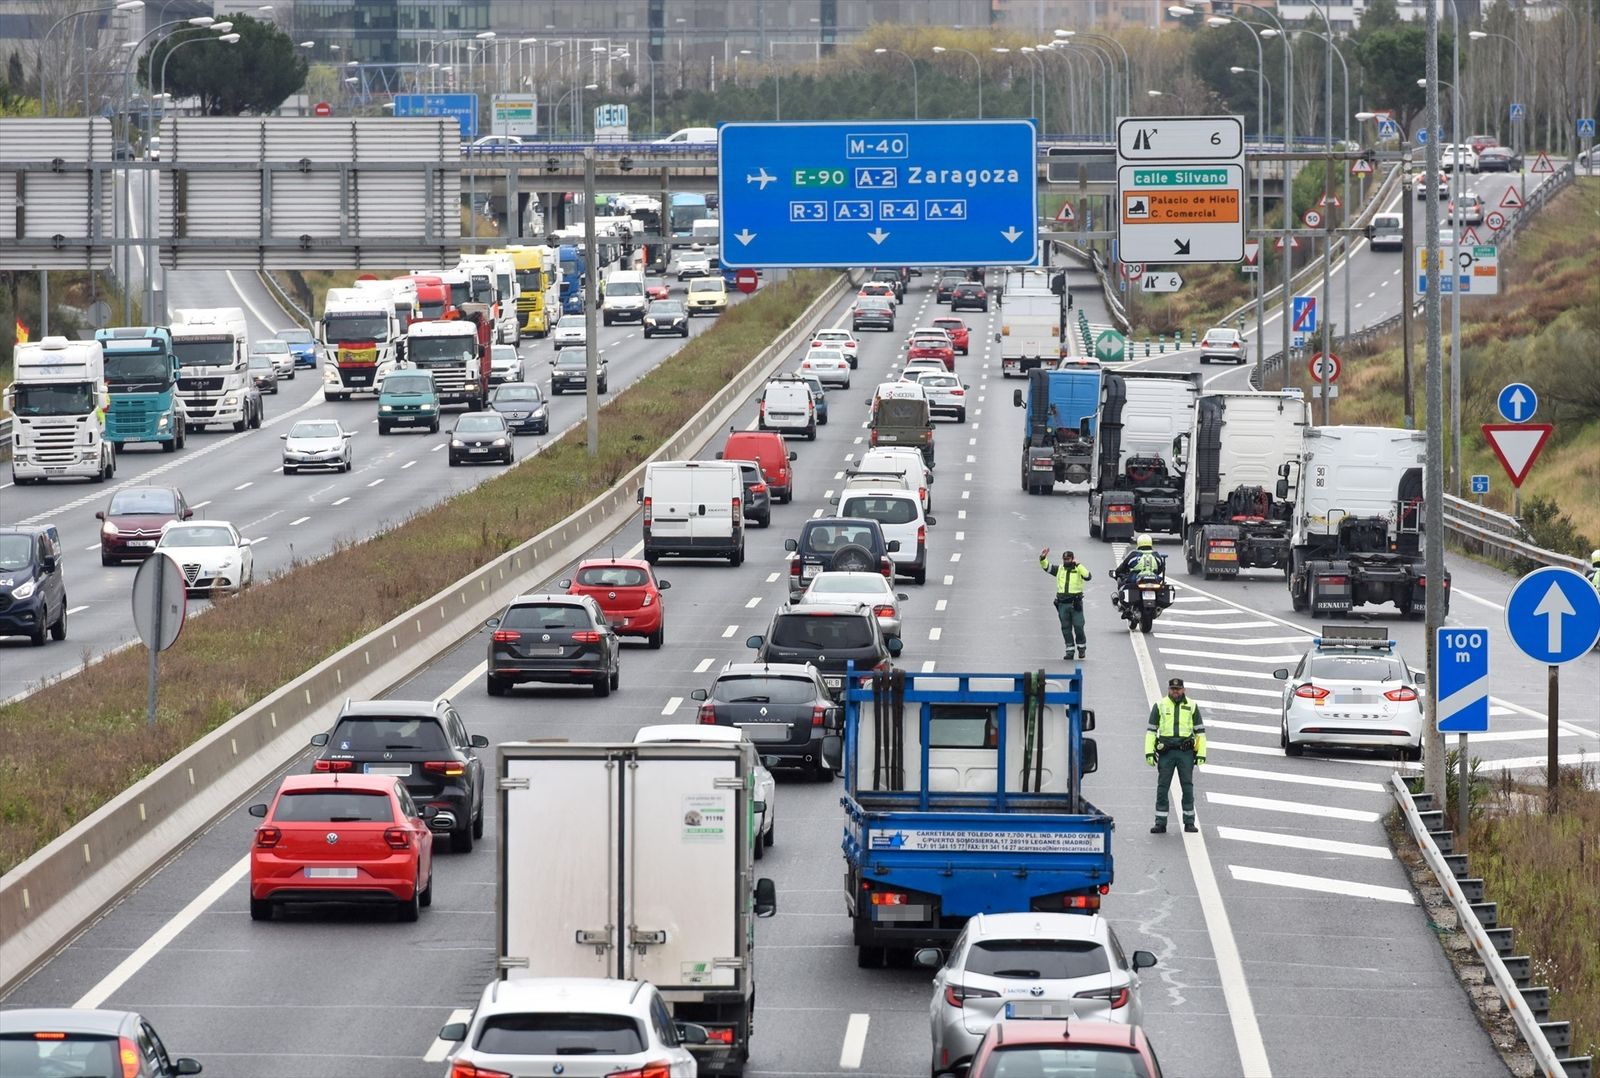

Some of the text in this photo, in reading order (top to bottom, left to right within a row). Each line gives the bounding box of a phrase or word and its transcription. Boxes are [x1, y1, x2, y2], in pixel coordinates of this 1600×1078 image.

[1210, 132, 1222, 145] 6
[850, 139, 904, 154] M-40
[795, 166, 1020, 188] E-90 A-2 Zaragoza
[1135, 171, 1227, 184] calle Silvano
[1151, 195, 1236, 204] Palacio de Hielo
[792, 203, 964, 219] R-3 A-3 R-4 A-4
[1151, 208, 1217, 218] C. Comercial
[1307, 214, 1318, 223] 50
[1490, 217, 1501, 226] 50
[1169, 277, 1177, 287] 6
[1316, 362, 1334, 373] 70
[1316, 467, 1325, 477] 90
[1316, 478, 1325, 488] 80
[1476, 483, 1484, 492] 9
[1317, 601, 1350, 609] RENAULT
[1445, 633, 1483, 649] 100
[1455, 650, 1471, 663] m
